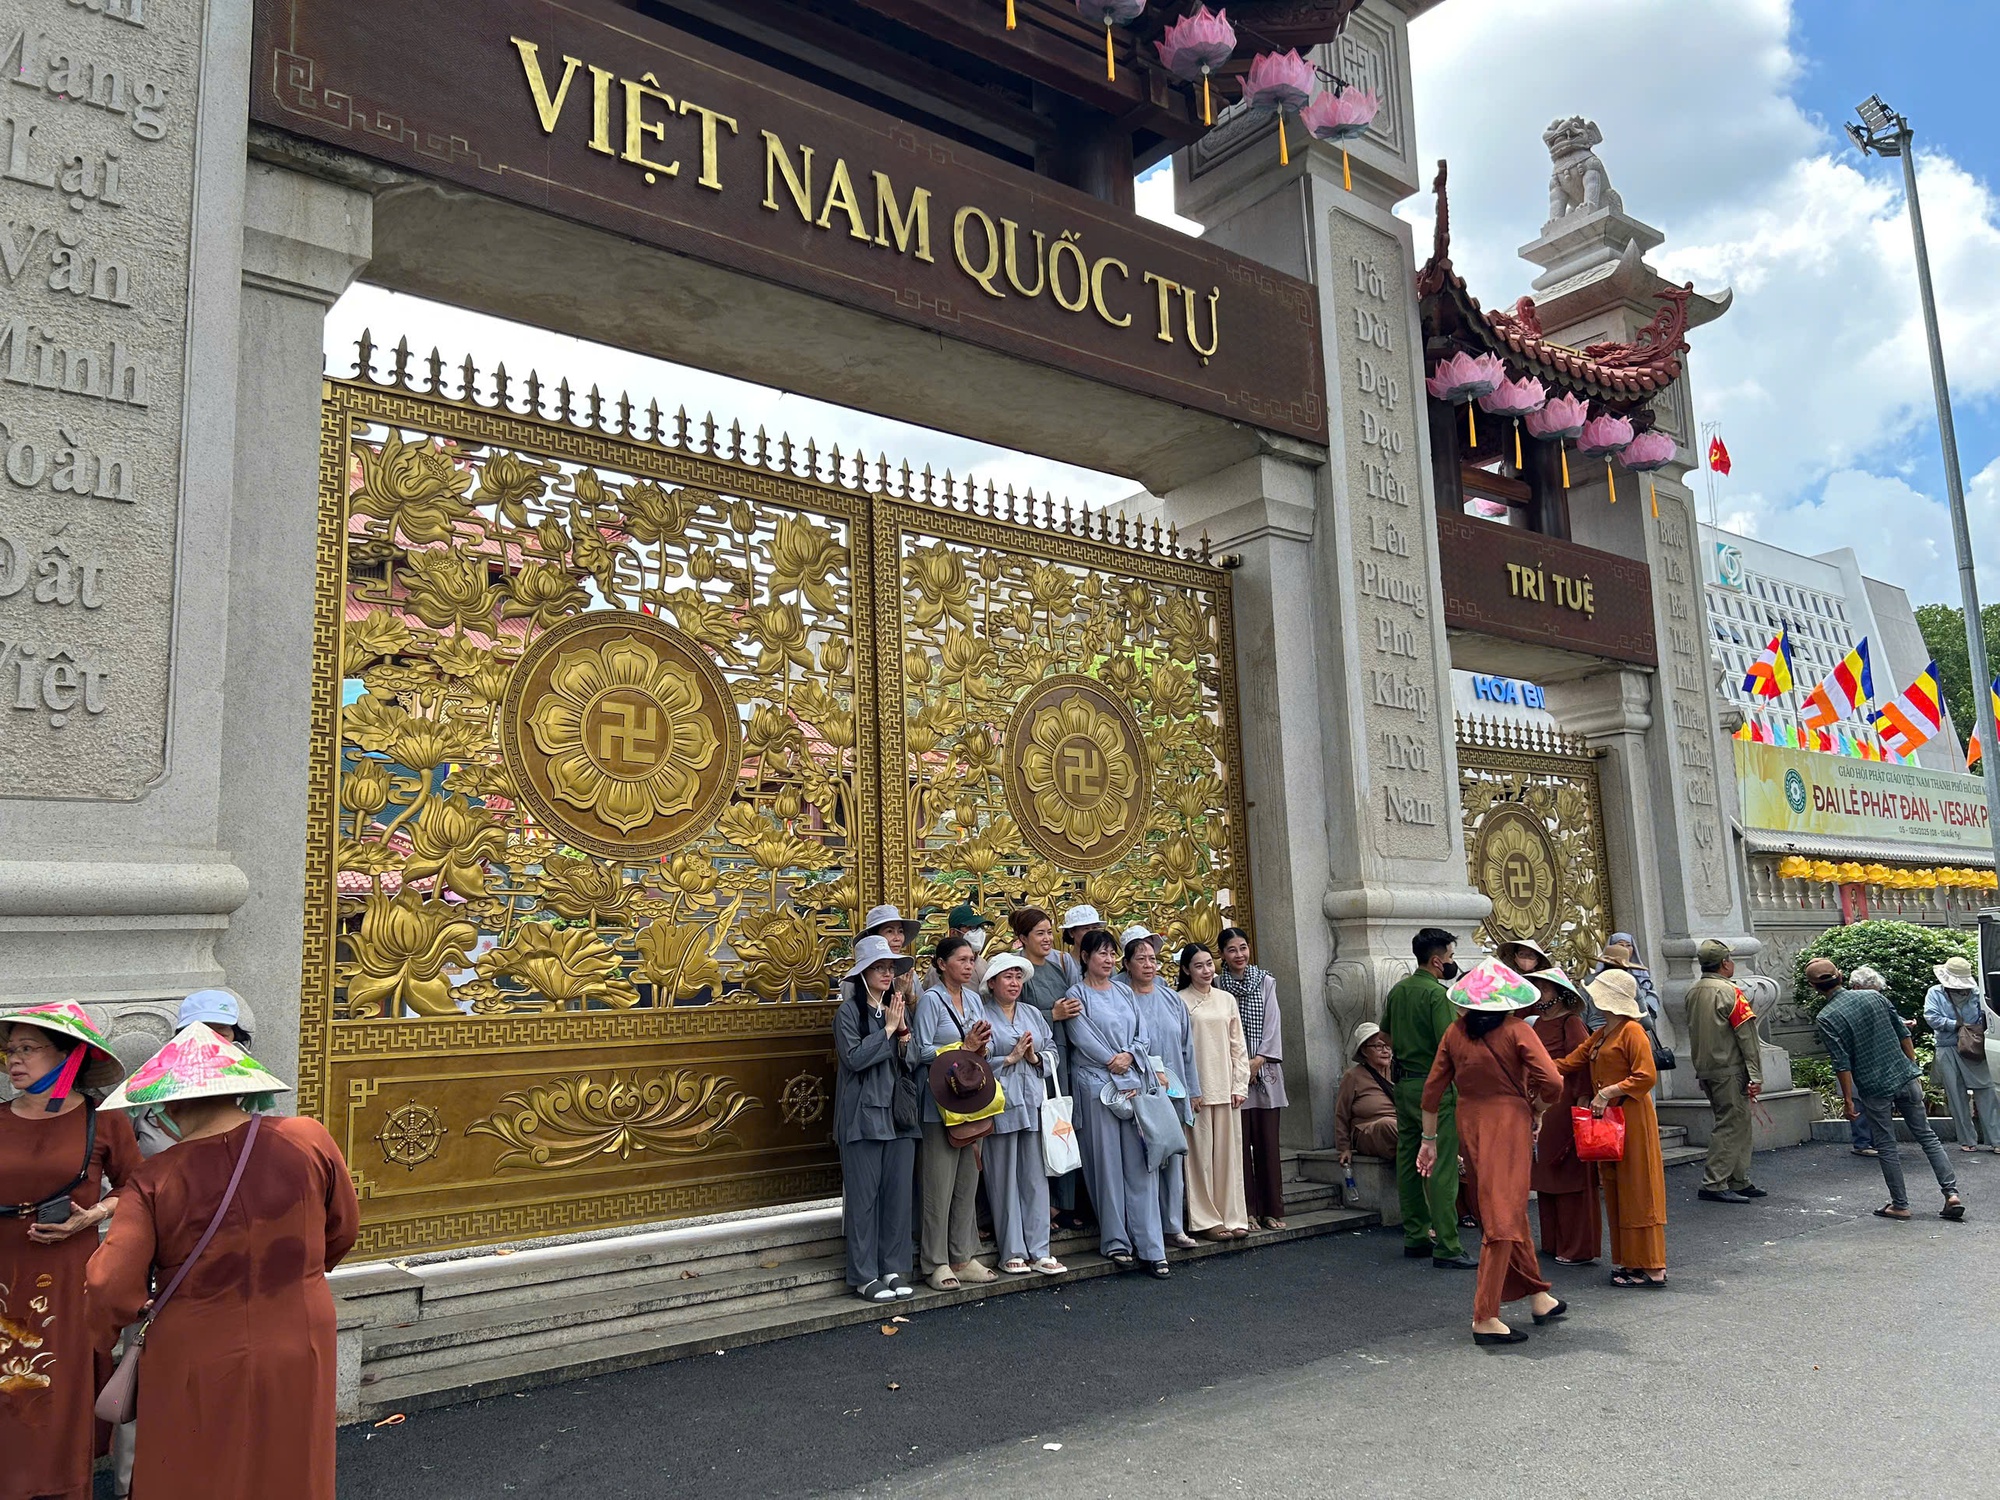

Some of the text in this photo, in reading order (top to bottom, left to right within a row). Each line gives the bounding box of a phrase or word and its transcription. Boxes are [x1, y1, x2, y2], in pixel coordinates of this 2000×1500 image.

[2, 117, 123, 212] Lại
[510, 35, 1220, 367] VIỆT NAM QUỐC TỰ
[0, 219, 131, 308] Văn
[1351, 255, 1387, 303] Tốt
[1353, 306, 1394, 354] Đời
[1356, 357, 1400, 413] Đẹp
[1360, 408, 1402, 460] Đạo
[0, 423, 137, 505] oàn
[1360, 460, 1409, 508] Tiến
[1368, 515, 1410, 559] Lên
[1359, 559, 1426, 620] Phong
[1506, 561, 1595, 621] TRÍ TUỆ
[1381, 729, 1429, 773] Trời
[1838, 765, 1855, 778] GIÁO
[1869, 769, 1886, 784] PHẬT
[1886, 771, 1901, 784] GIÁO
[1916, 776, 1930, 788] NAM
[1383, 785, 1436, 827] Nam
[1812, 784, 1840, 815] ĐẠI
[1861, 789, 1898, 820] PHẬT
[1938, 800, 1981, 828] VESAK
